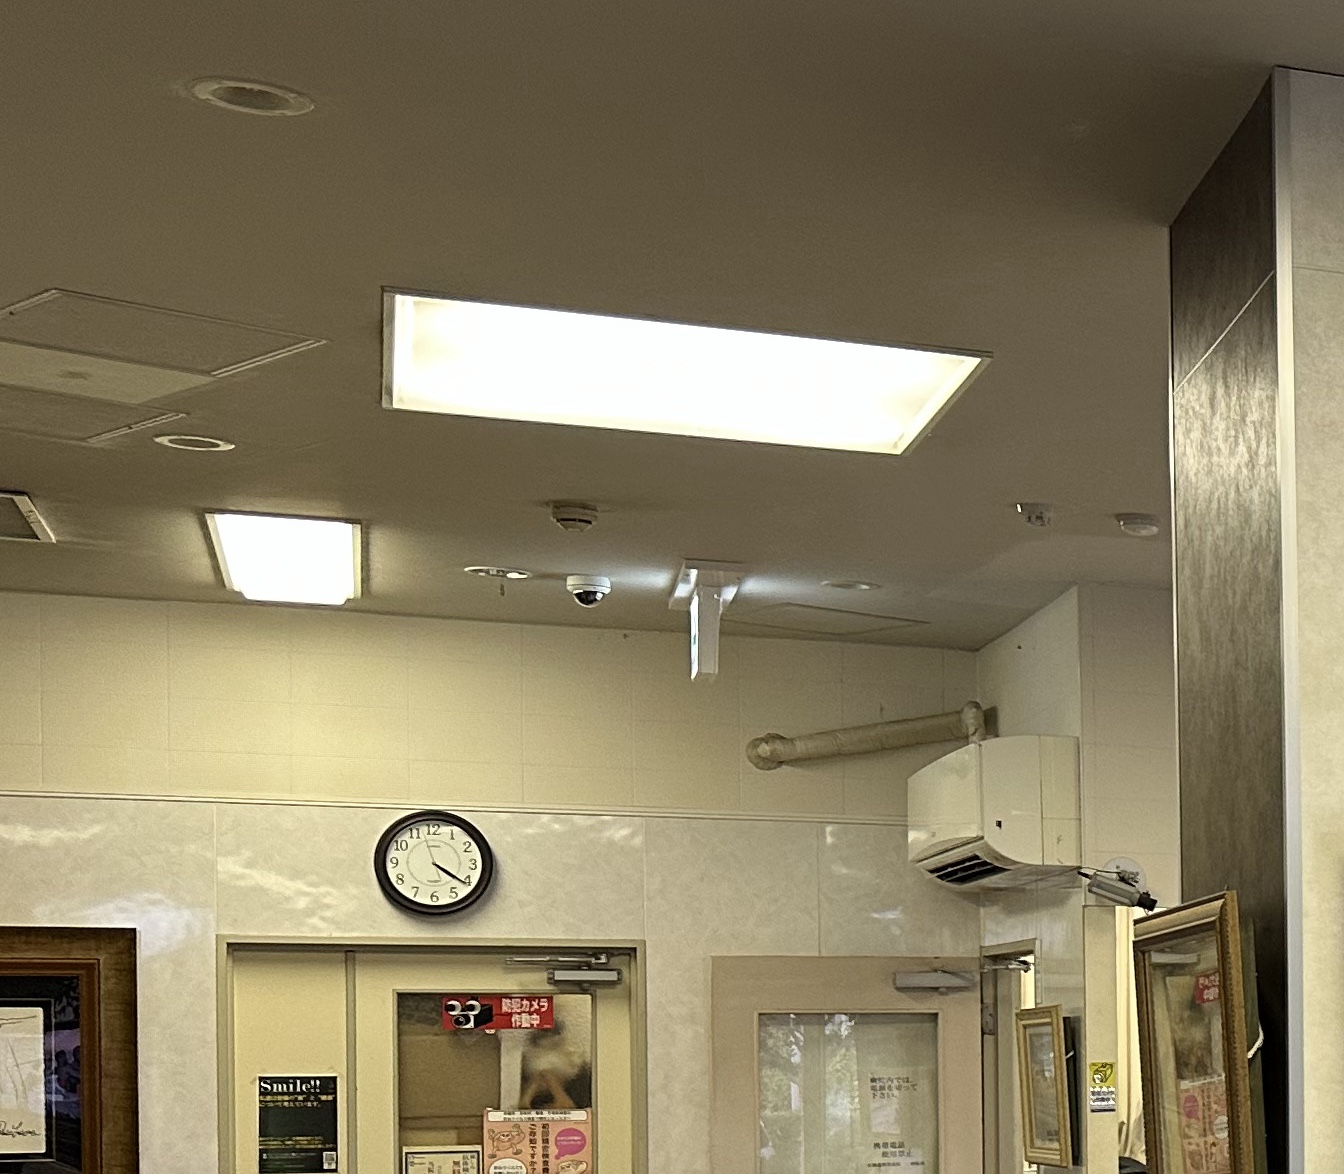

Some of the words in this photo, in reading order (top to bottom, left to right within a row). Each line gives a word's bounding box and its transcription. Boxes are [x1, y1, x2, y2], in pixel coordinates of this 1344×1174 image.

[408, 827, 421, 840] 11
[425, 823, 441, 836] 12
[449, 828, 456, 841] 1
[393, 840, 409, 852] 10
[462, 840, 473, 853] 2
[389, 856, 399, 869] 9
[468, 858, 478, 871] 3
[395, 873, 405, 886] 8
[463, 874, 472, 887] 4
[411, 886, 420, 899] 7
[429, 890, 440, 903] 6
[448, 886, 459, 899] 5
[501, 998, 549, 1013] 防犯カメラ
[511, 1013, 541, 1028] 作動中
[260, 1079, 321, 1093] Smile!!
